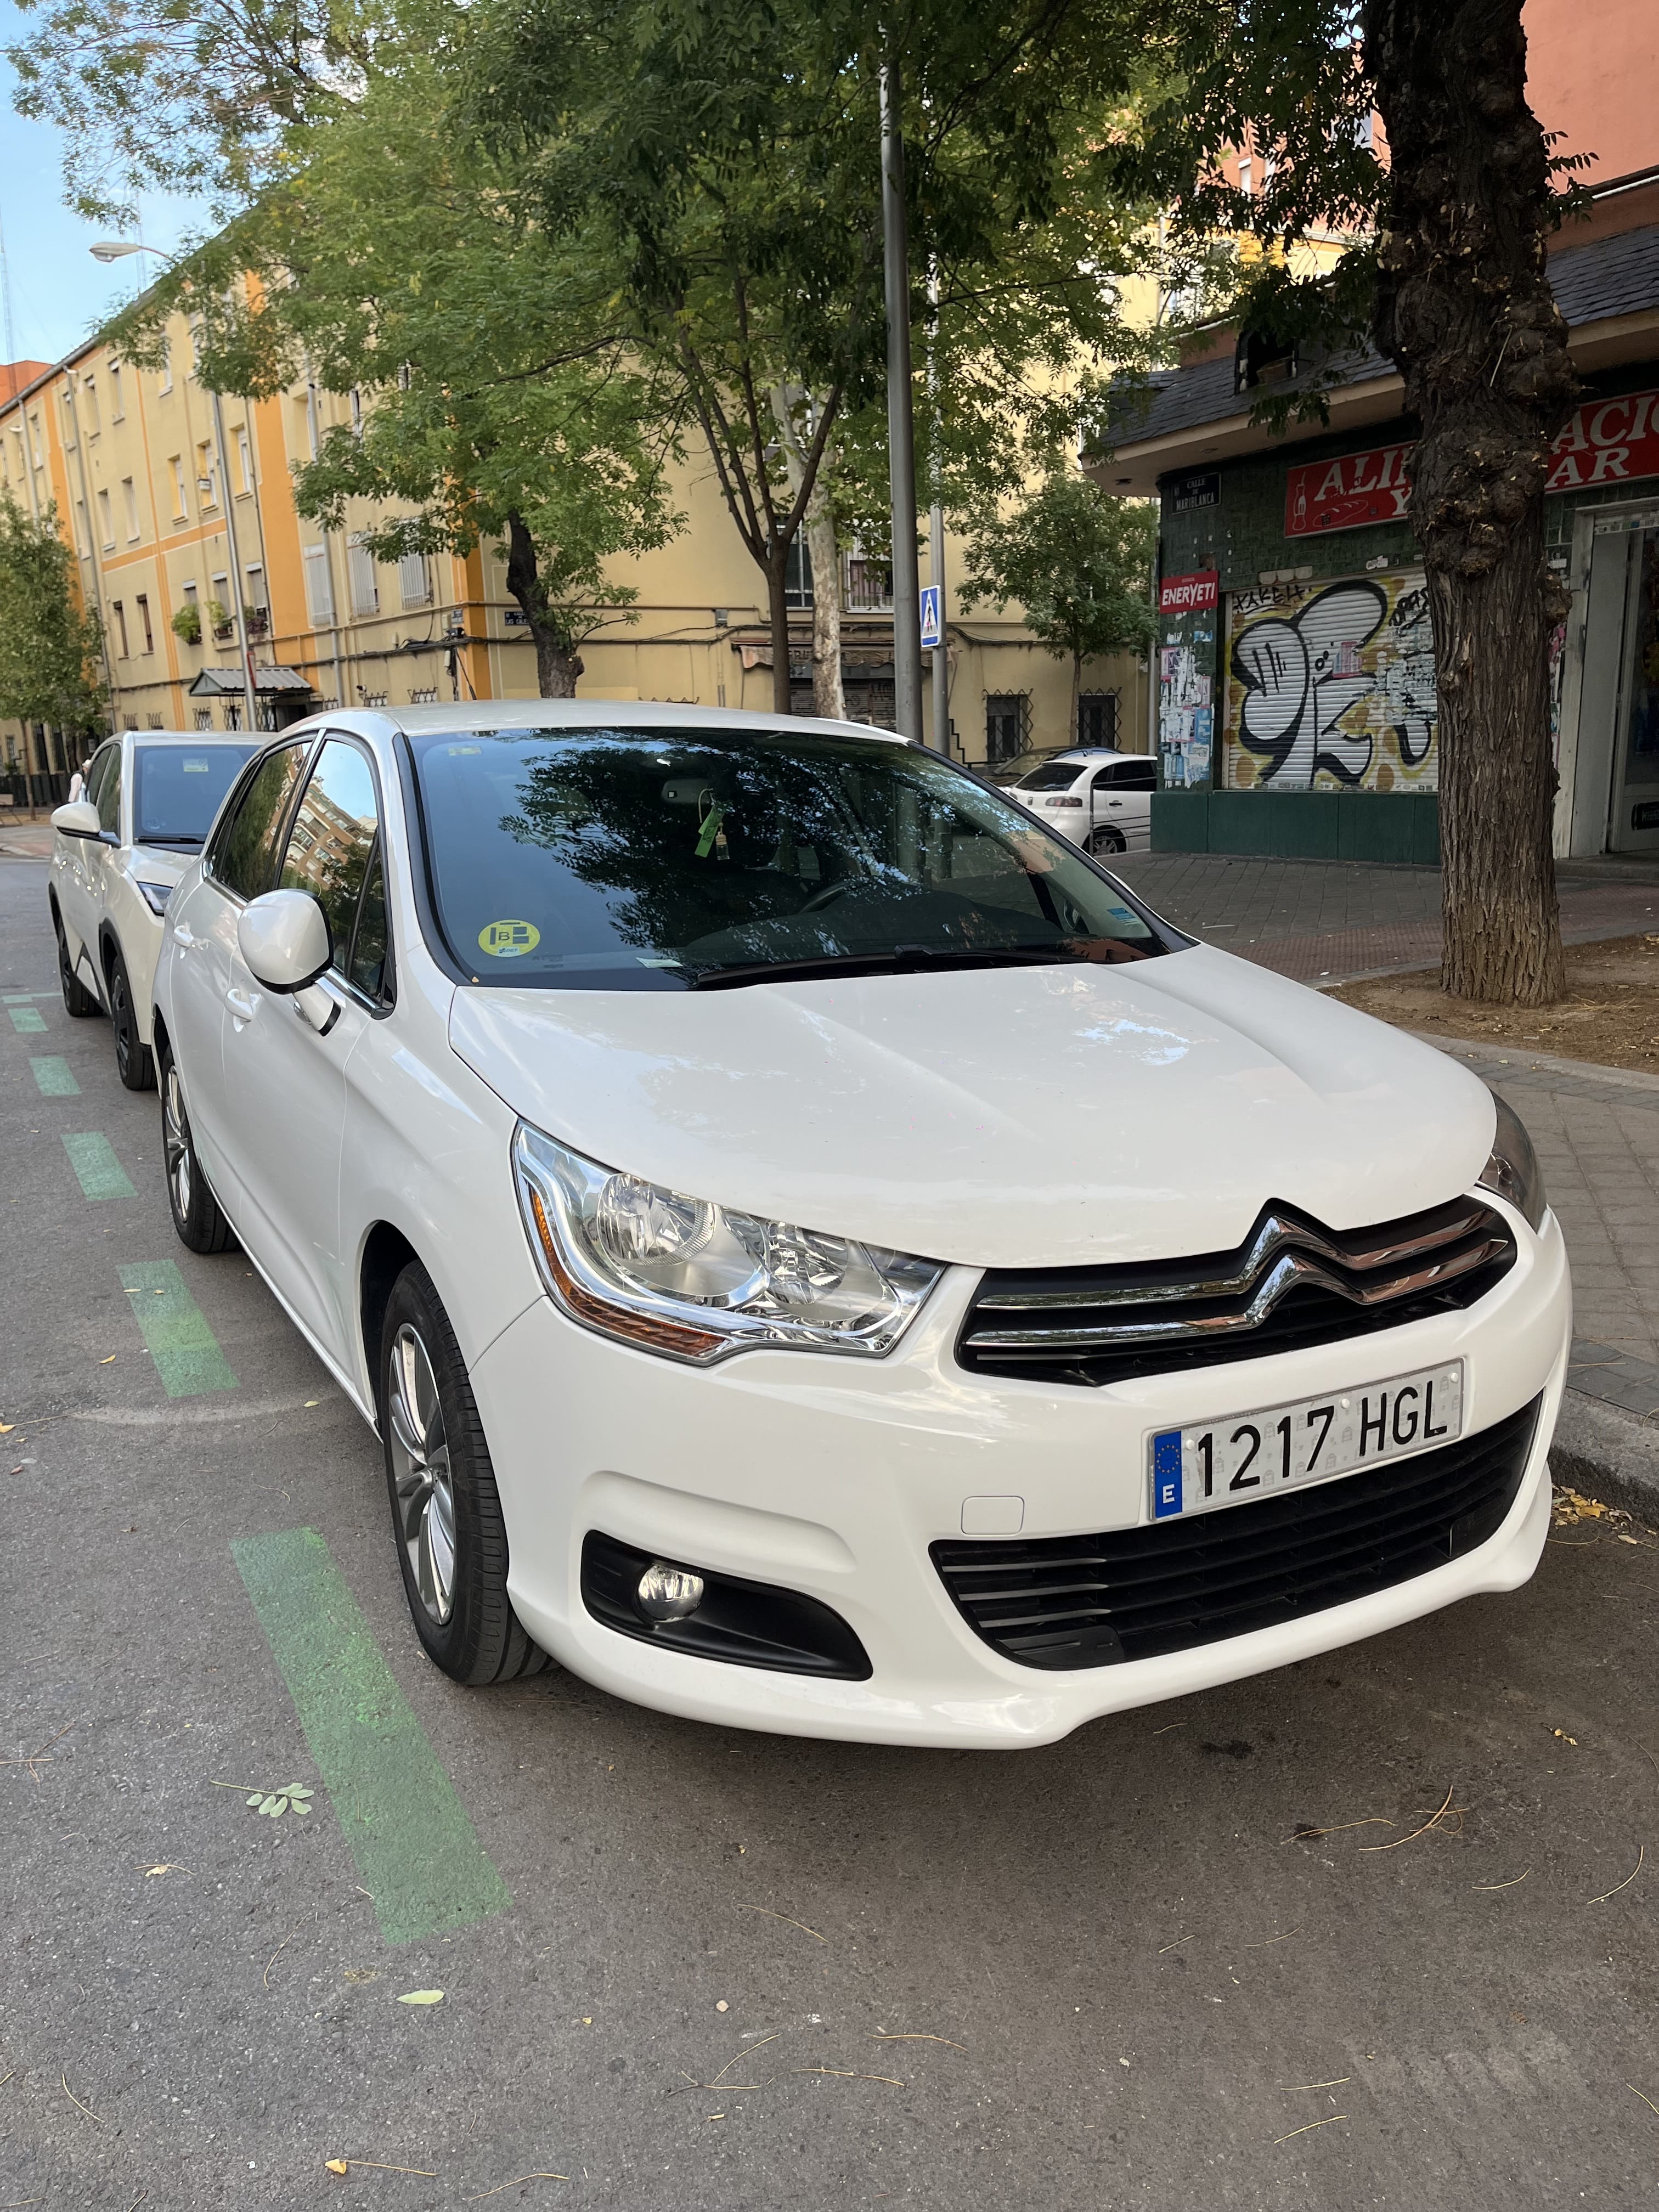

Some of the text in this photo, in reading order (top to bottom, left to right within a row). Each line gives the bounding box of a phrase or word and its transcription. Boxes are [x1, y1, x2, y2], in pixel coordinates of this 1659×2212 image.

[1544, 447, 1629, 488] AR
[1187, 478, 1206, 489] CALLE
[1176, 492, 1215, 511] MARIBLANCA
[1162, 582, 1215, 606] ENERYETI
[499, 932, 510, 941] B
[1198, 1381, 1448, 1497] 1217 HGL
[1162, 1483, 1175, 1504] E
